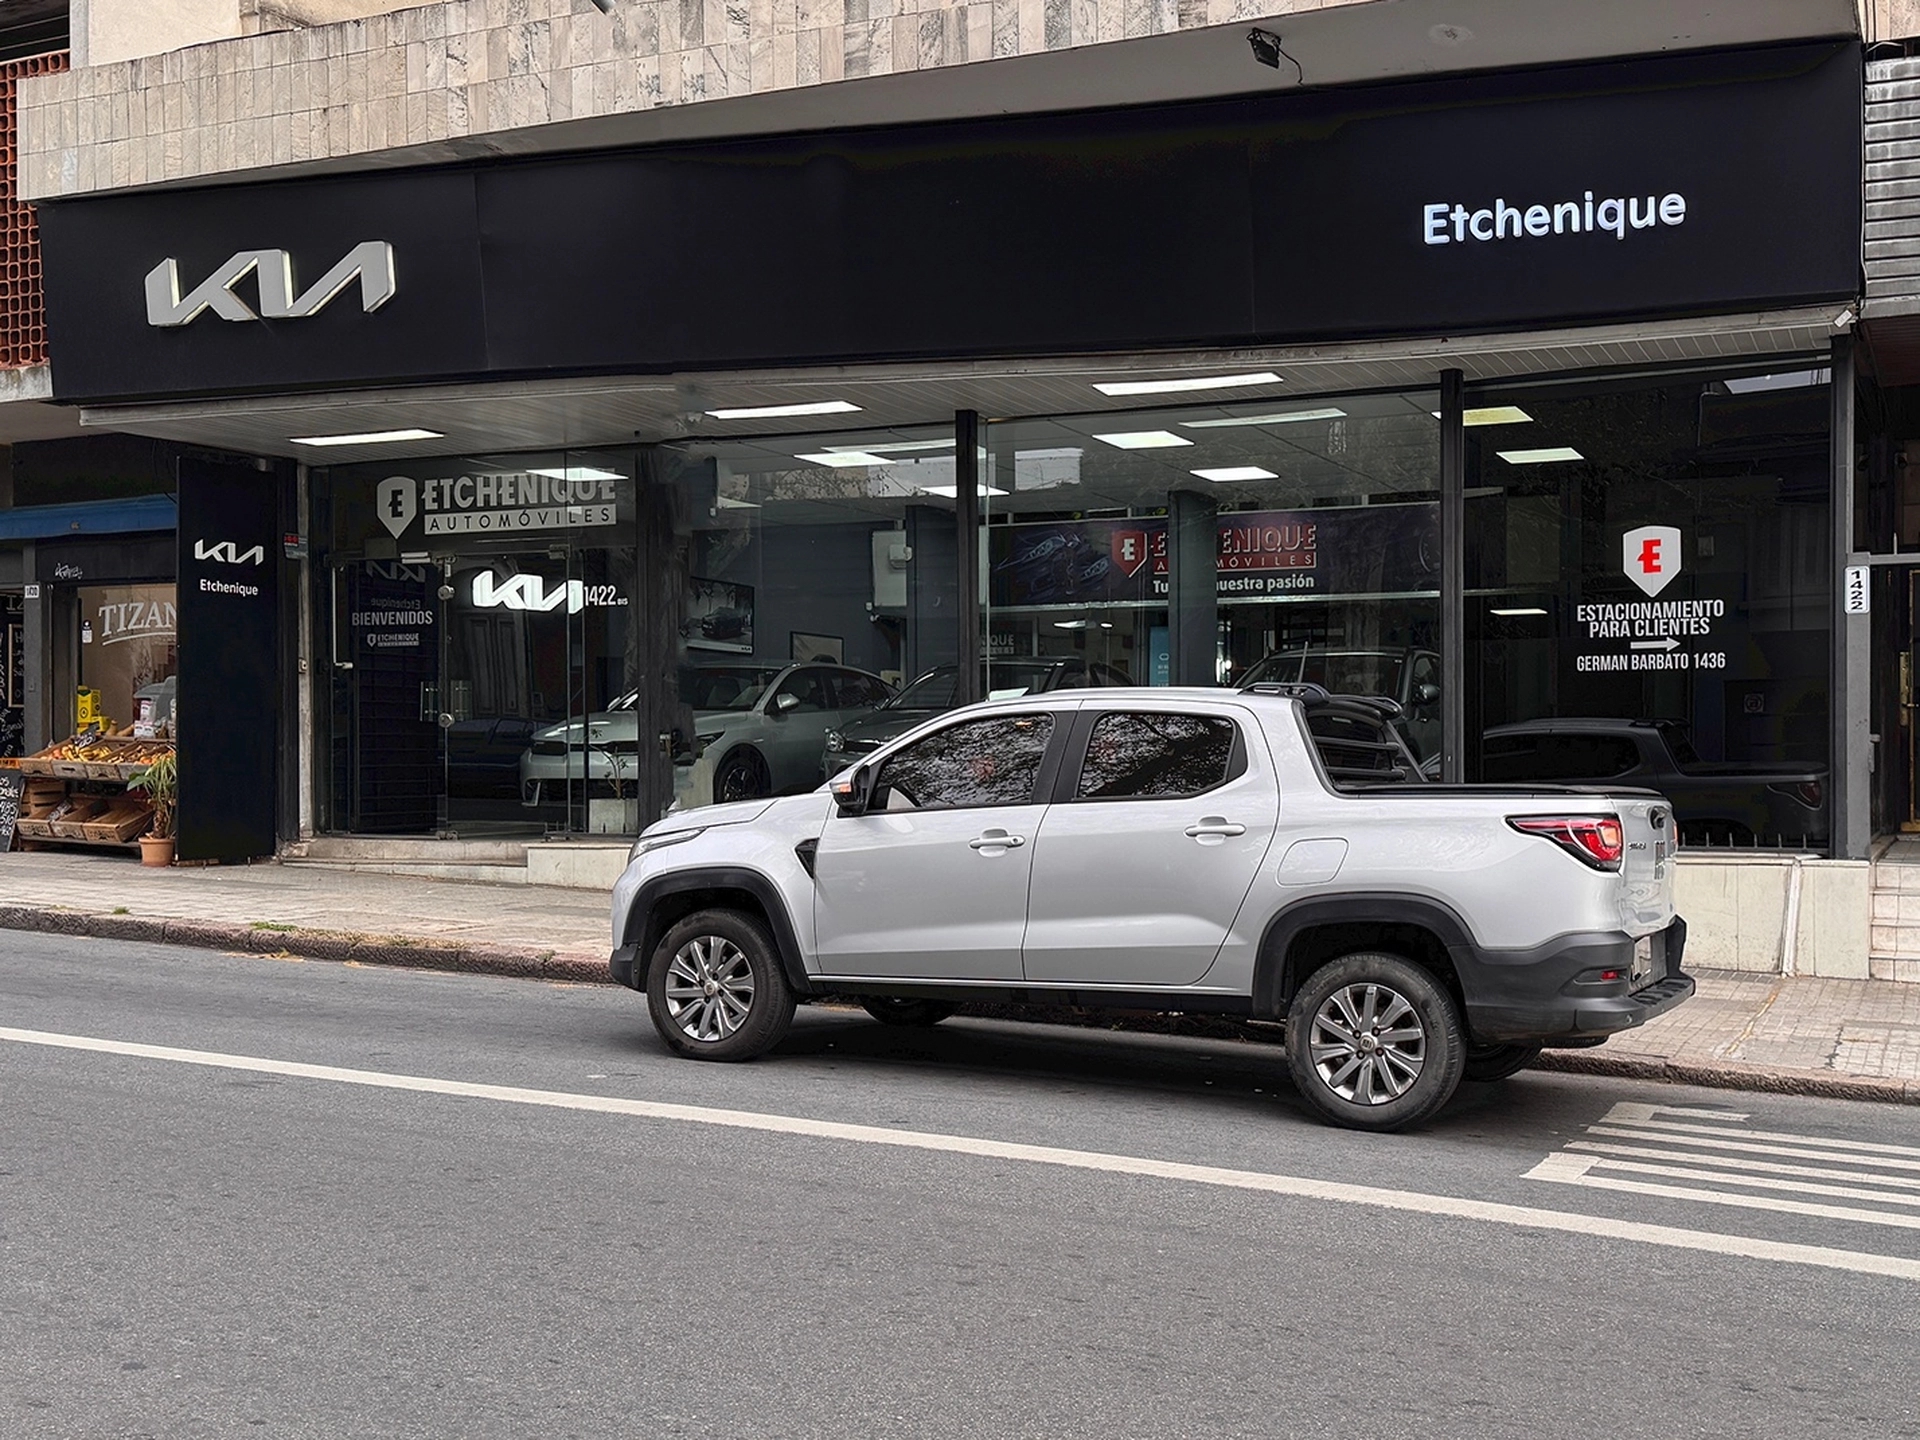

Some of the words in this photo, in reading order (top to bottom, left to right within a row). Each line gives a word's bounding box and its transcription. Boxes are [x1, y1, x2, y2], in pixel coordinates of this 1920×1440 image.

[1423, 191, 1686, 244] Etchenique
[145, 240, 396, 327] KIA
[422, 468, 615, 510] ETCHENIQUE
[430, 507, 610, 532] AUTOMÓVILES
[195, 539, 264, 566] KIA
[200, 578, 259, 597] Etchenique
[473, 570, 584, 615] KIA
[584, 586, 616, 606] 1422
[1153, 579, 1169, 593] Tu
[1267, 574, 1314, 592] pasión
[1850, 570, 1863, 610] 1422
[351, 610, 433, 626] BIENVENIDOS
[1577, 599, 1724, 622] ESTACIONAMIENTO
[1589, 620, 1631, 638] PARA
[1634, 616, 1710, 637] CLIENTES
[1576, 655, 1628, 671] GERMAN
[1631, 653, 1689, 670] BARBATO
[1693, 652, 1726, 669] 1436
